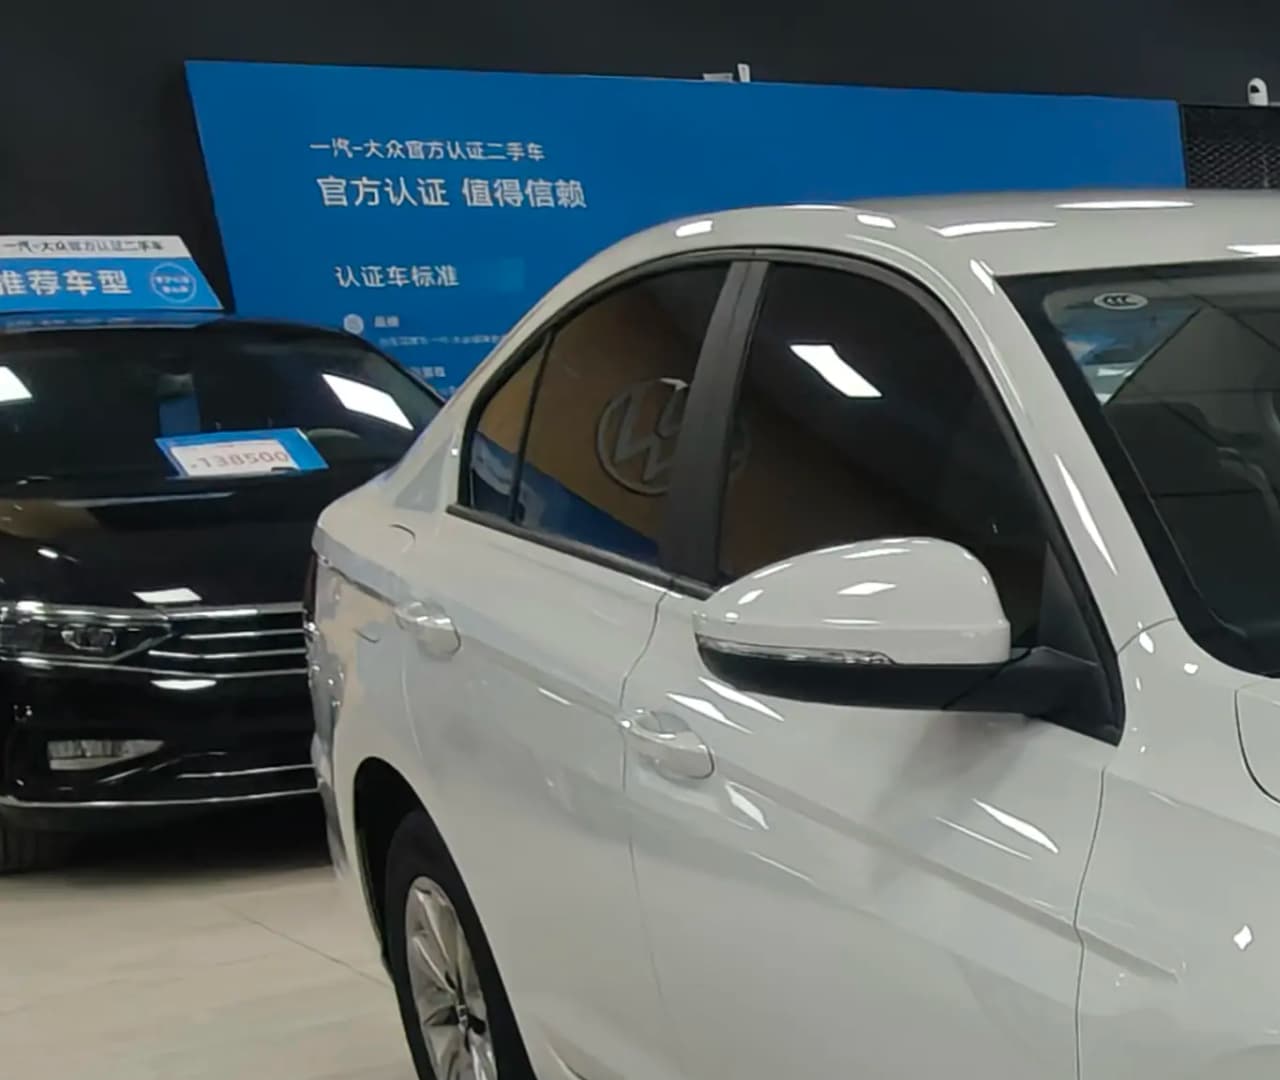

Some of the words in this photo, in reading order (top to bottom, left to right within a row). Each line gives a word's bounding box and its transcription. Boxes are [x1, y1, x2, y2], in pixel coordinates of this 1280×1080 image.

[309, 137, 545, 162] 一汽-大众官方认证二手车
[316, 175, 450, 207] 官方认证
[461, 178, 588, 208] 值得信赖
[0, 269, 132, 296] 推荐车型
[334, 265, 460, 287] 认证车标准
